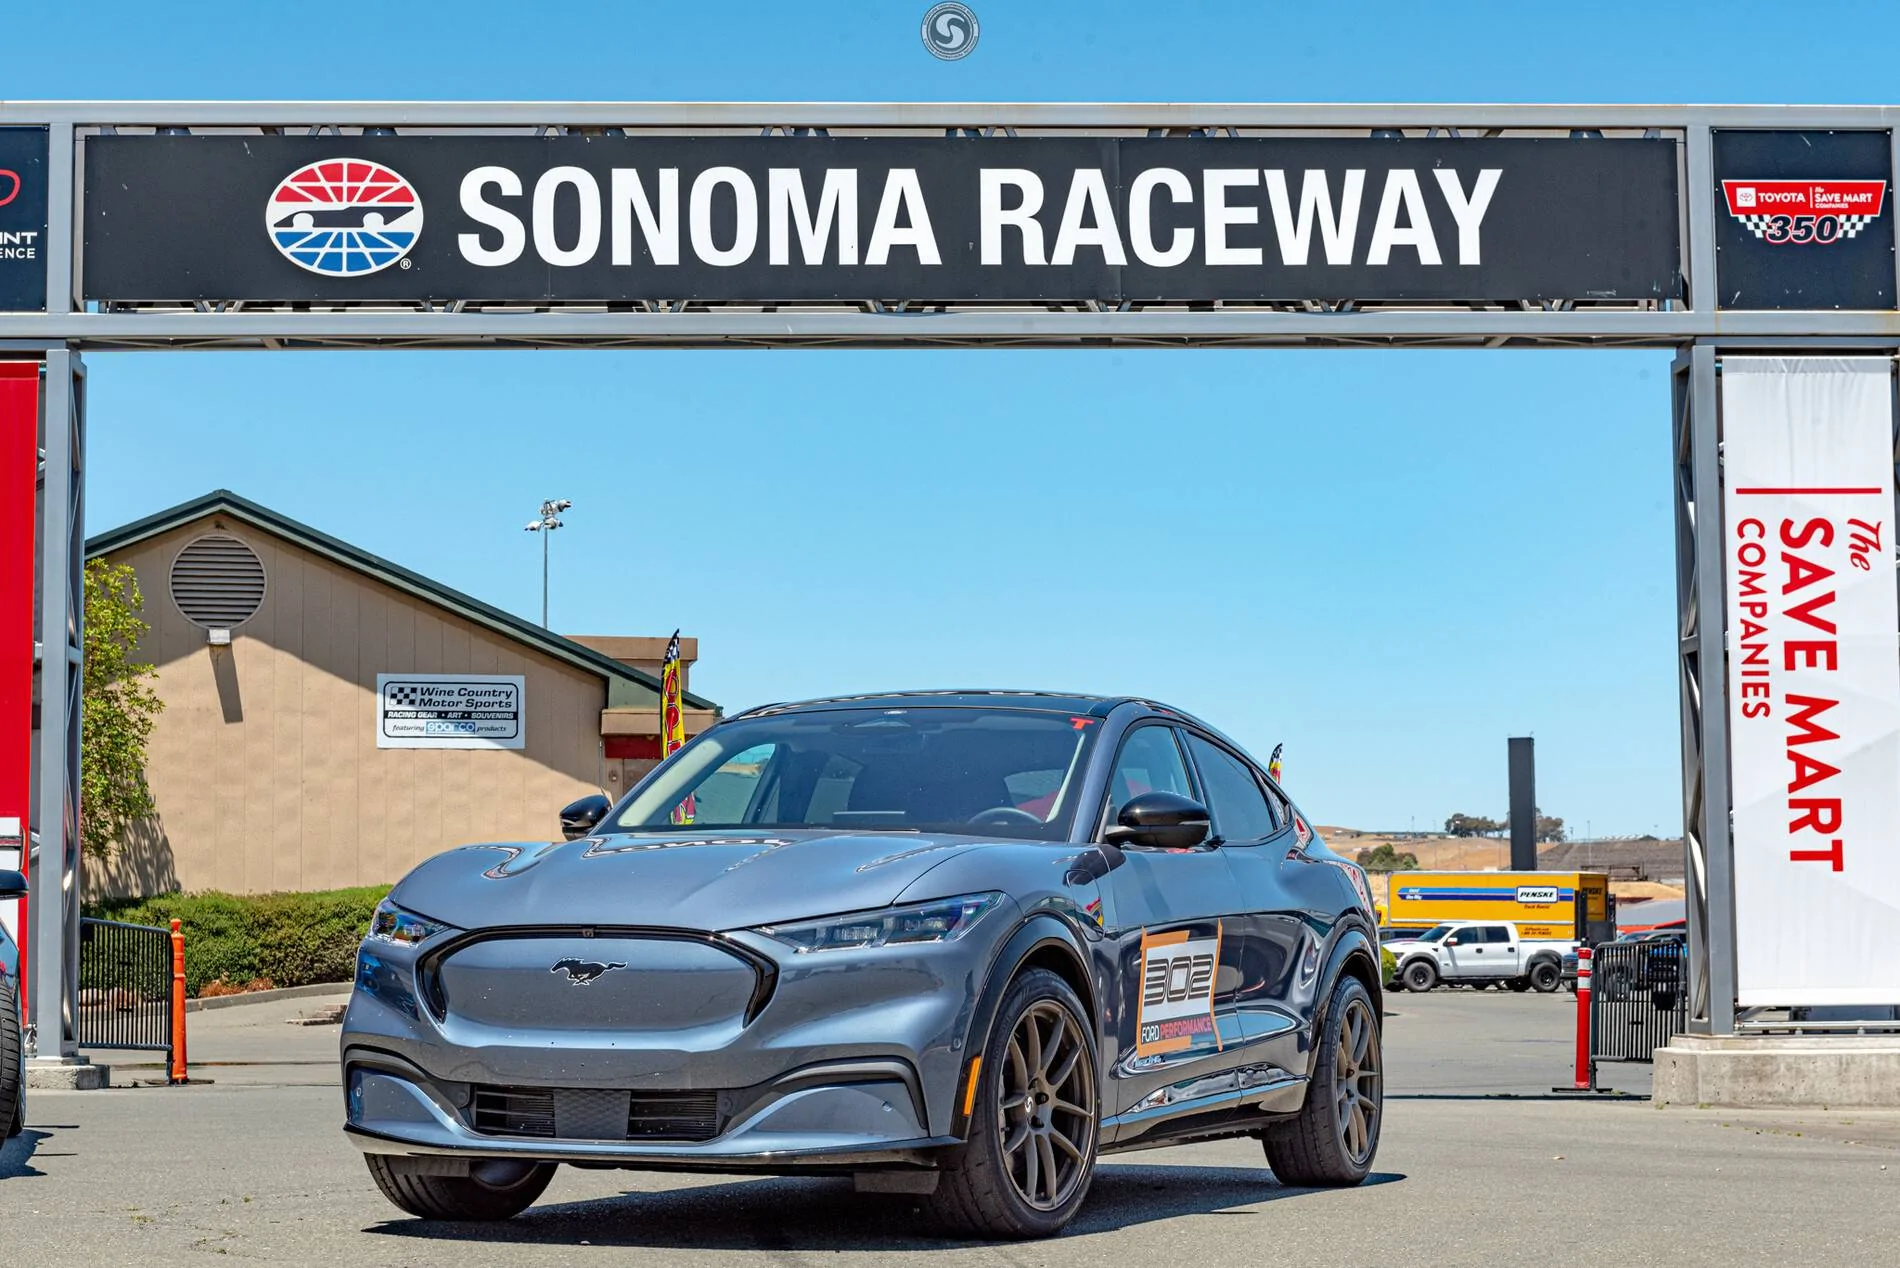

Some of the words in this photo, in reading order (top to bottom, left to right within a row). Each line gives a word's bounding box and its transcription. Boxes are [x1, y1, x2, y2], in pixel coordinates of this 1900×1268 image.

[1758, 192, 1806, 203] TOYOTA
[1815, 193, 1841, 203] SAVE
[1843, 193, 1873, 203] MART
[457, 165, 943, 267] SONOMA
[979, 167, 1503, 267] RACEWAY
[1766, 214, 1839, 244] 350
[1847, 517, 1882, 571] The
[1779, 517, 1838, 671] SAVE
[1736, 518, 1771, 719] COMPANIES
[418, 698, 463, 708] Motor
[465, 698, 512, 709] Sports
[420, 687, 455, 697] Wine
[457, 687, 513, 700] Country
[387, 711, 417, 719] RACING
[418, 711, 438, 719] GEAR
[446, 711, 463, 719] ART
[392, 724, 425, 733] featuring
[427, 722, 475, 733] sparco
[476, 725, 507, 734] products
[1784, 693, 1844, 872] MART
[1143, 953, 1214, 1007] 302
[1141, 1024, 1160, 1043] FORD
[1159, 1016, 1212, 1040] PERFORMANCE
